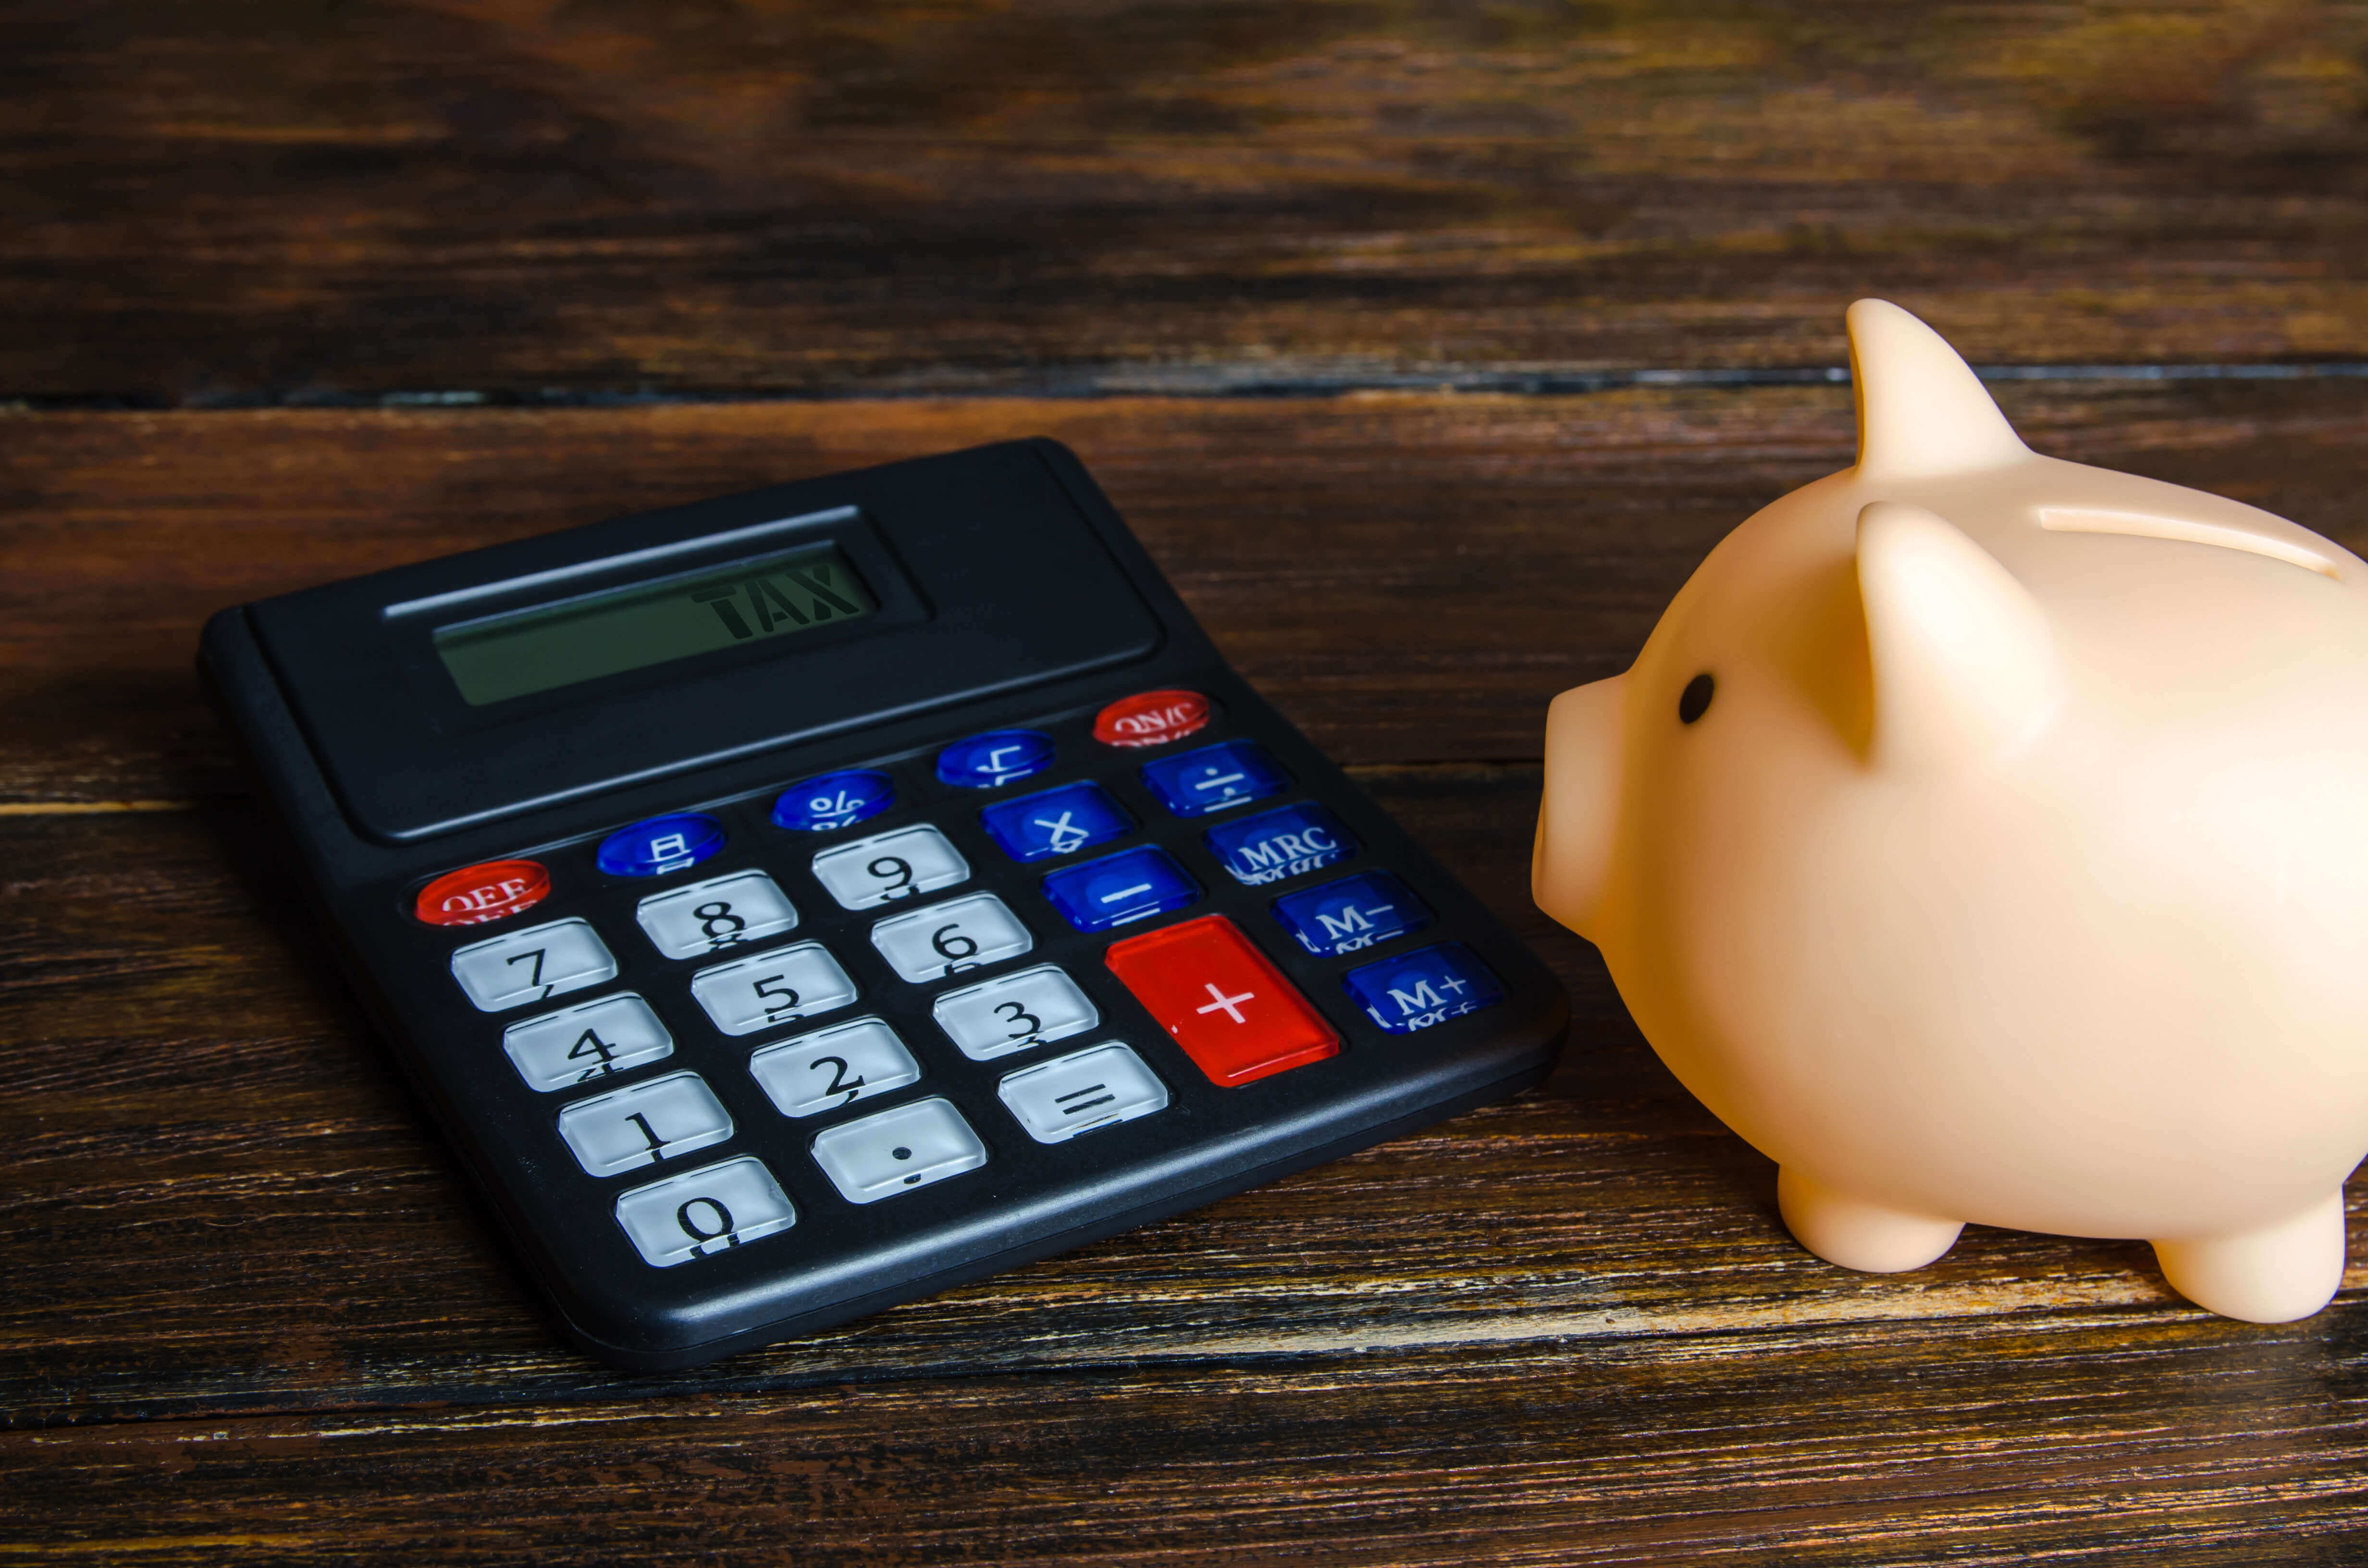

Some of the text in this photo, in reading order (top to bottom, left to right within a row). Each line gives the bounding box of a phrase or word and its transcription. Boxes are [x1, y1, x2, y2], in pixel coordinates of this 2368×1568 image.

[691, 564, 860, 639] TAX
[1238, 827, 1337, 871] MRC
[867, 856, 913, 891] 9
[442, 877, 529, 912] OFF
[693, 901, 745, 940] 8
[932, 923, 978, 960] 6
[506, 948, 546, 986] 7
[752, 974, 801, 1012] 5
[1387, 975, 1467, 1017] M+
[993, 1001, 1041, 1039] 3
[567, 1028, 621, 1065] 4
[810, 1056, 866, 1096] 2
[625, 1112, 671, 1151] 1
[677, 1197, 735, 1244] 0
